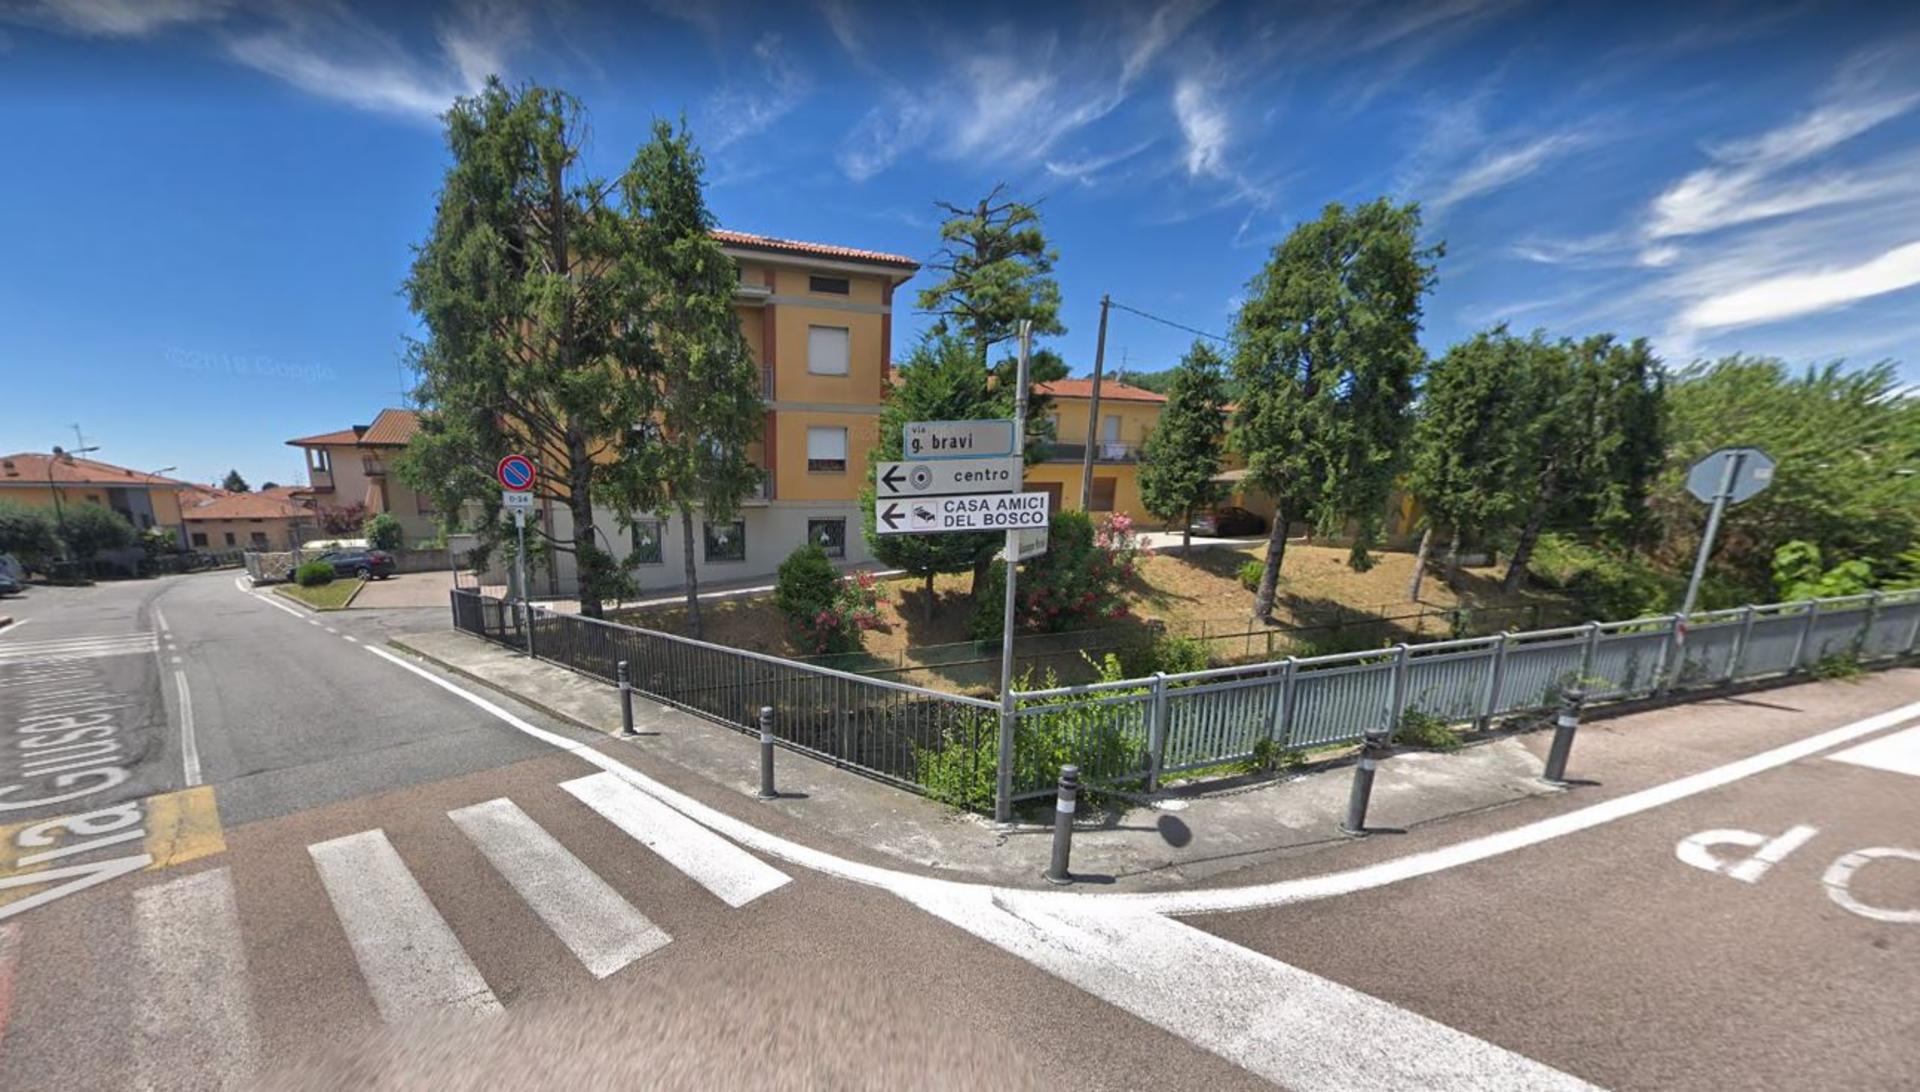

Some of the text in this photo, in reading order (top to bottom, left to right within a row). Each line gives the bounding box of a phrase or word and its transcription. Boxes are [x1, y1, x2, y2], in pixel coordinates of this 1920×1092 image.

[912, 426, 926, 434] via
[912, 433, 973, 453] g. bravi
[954, 469, 1009, 482] centro
[944, 497, 1044, 513] CASA AMICI
[944, 511, 1044, 527] DEL BOSCO
